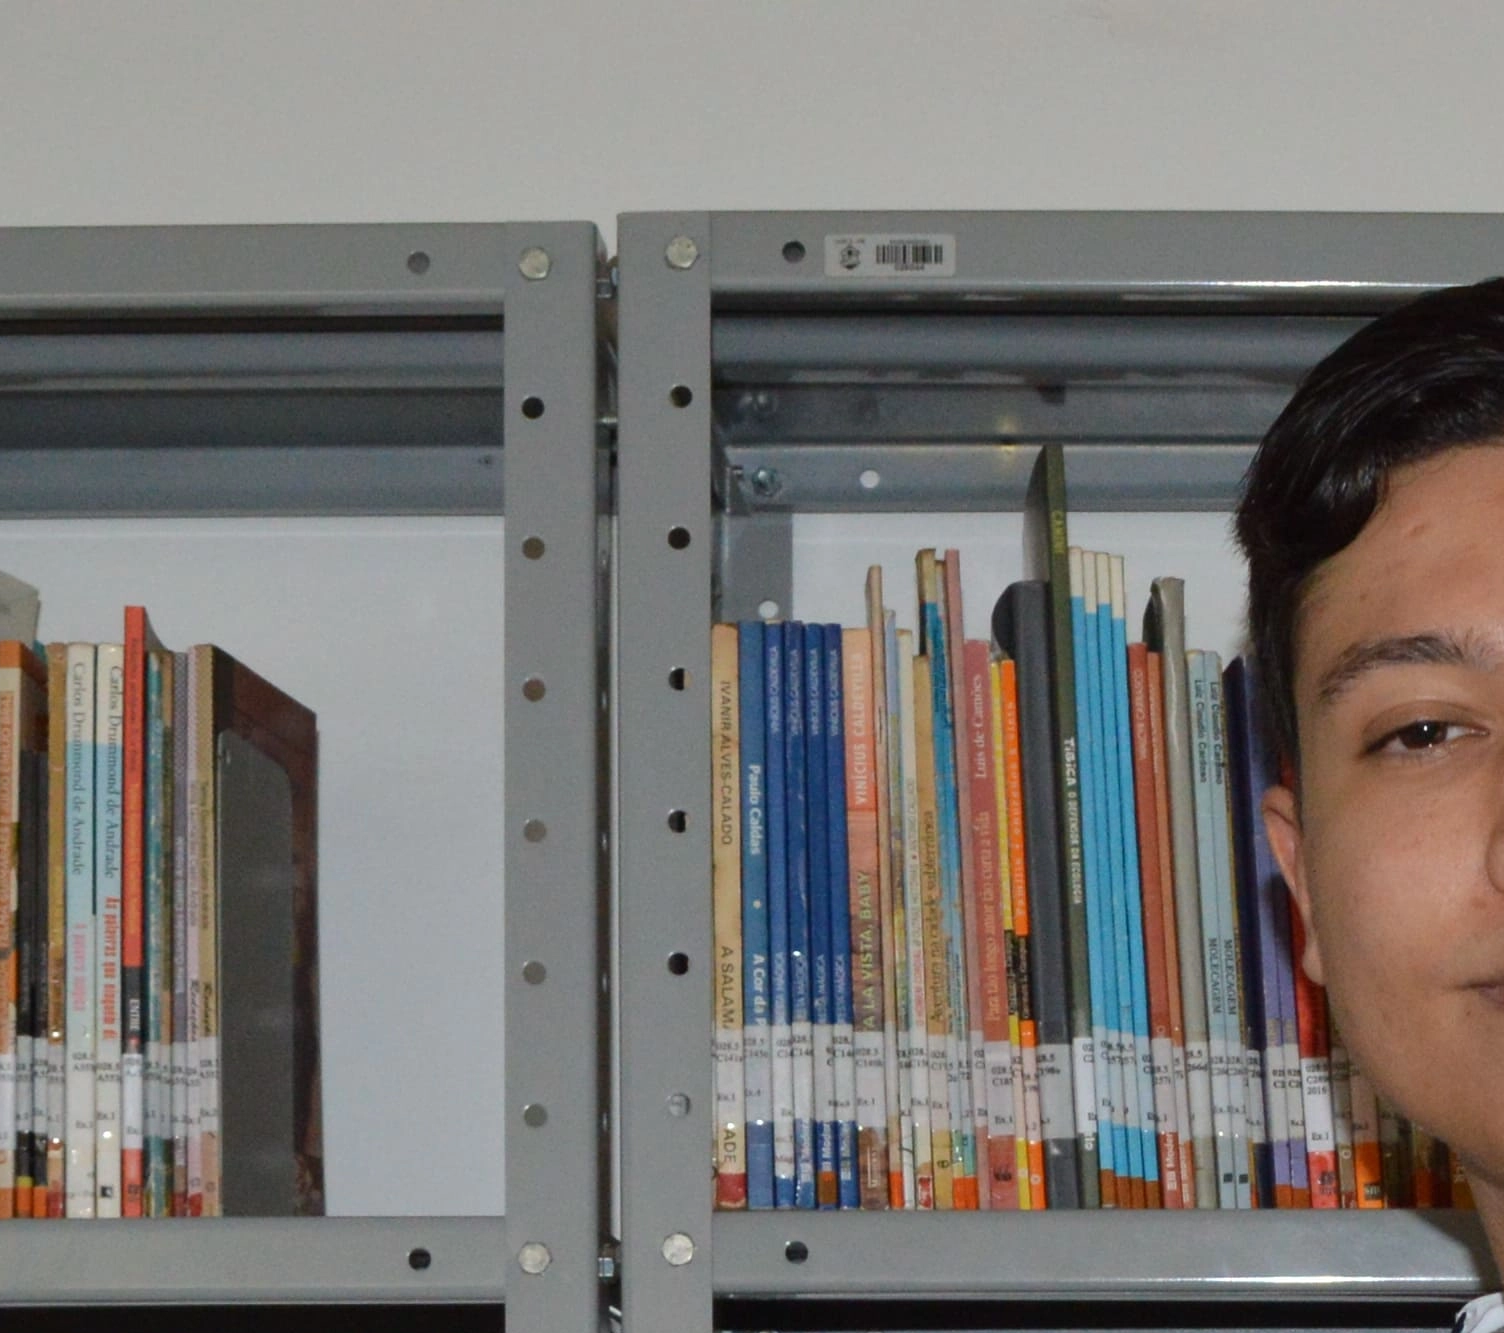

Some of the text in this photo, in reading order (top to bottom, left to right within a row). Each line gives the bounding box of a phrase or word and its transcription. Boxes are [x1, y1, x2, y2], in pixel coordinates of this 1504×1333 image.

[71, 662, 86, 875] Carlos Drummond de Andrade
[103, 665, 123, 879] Carlos Drummond de Andrade
[720, 681, 733, 845] IVANIR ALVES-CALADO
[850, 652, 868, 805] VINÍCIUS CALDEVILLA
[748, 765, 762, 856] Paulo Caldas
[858, 871, 874, 1010] LA VISTA, BABY
[1208, 937, 1222, 1014] MOLECAGEM
[1224, 939, 1236, 1016] MOLECAGEM
